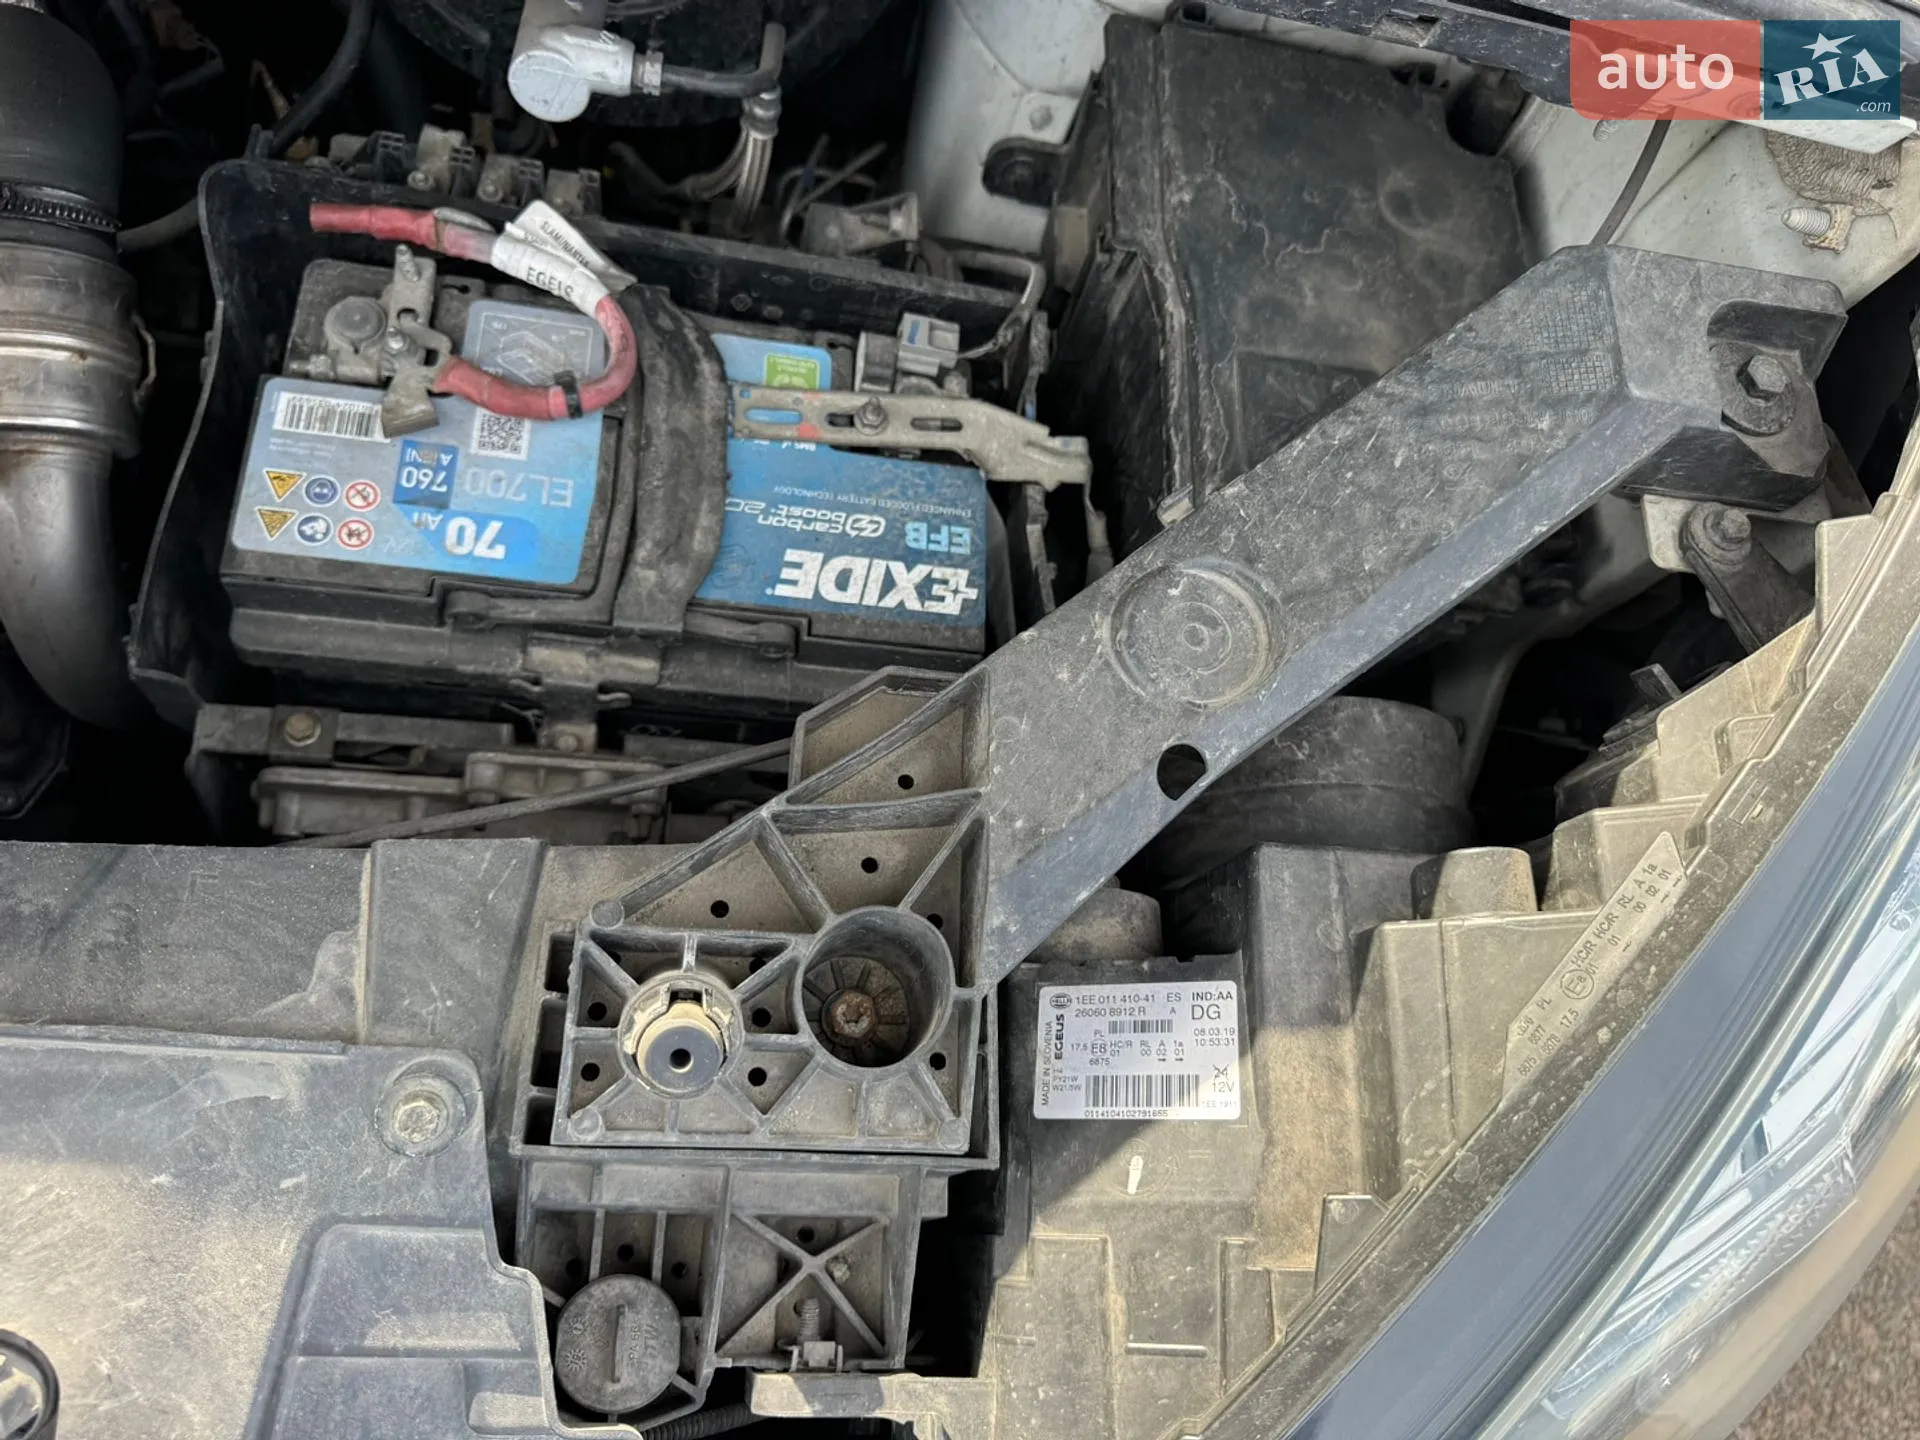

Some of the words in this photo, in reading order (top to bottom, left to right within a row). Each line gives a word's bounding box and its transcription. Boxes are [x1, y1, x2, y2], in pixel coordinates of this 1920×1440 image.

[400, 467, 448, 494] 760
[465, 466, 575, 508] EL700
[772, 485, 834, 502] TECHNOLOGY
[837, 492, 876, 507] BATTERY
[778, 504, 848, 522] boost
[918, 502, 973, 519] ENHANCED
[757, 514, 843, 535] carbon
[444, 516, 507, 560] 70
[904, 521, 972, 555] EFB
[774, 548, 979, 616] EXIDE
[1658, 868, 1672, 880] 01
[1617, 893, 1634, 909] RL
[1633, 877, 1647, 889] A
[1642, 864, 1658, 876] 1a
[1076, 995, 1096, 1005] 1EE
[1120, 994, 1155, 1004] 410-41
[1166, 992, 1182, 1002] ES
[1138, 1006, 1146, 1016] R
[1169, 1006, 1177, 1015] A
[1191, 1004, 1221, 1020] DG
[1043, 1020, 1053, 1065] SLOVENIA
[1054, 1013, 1065, 1060] EGEUS
[1043, 1067, 1051, 1077] IN
[1041, 1079, 1050, 1106] MADE
[1212, 1081, 1235, 1093] 12V
